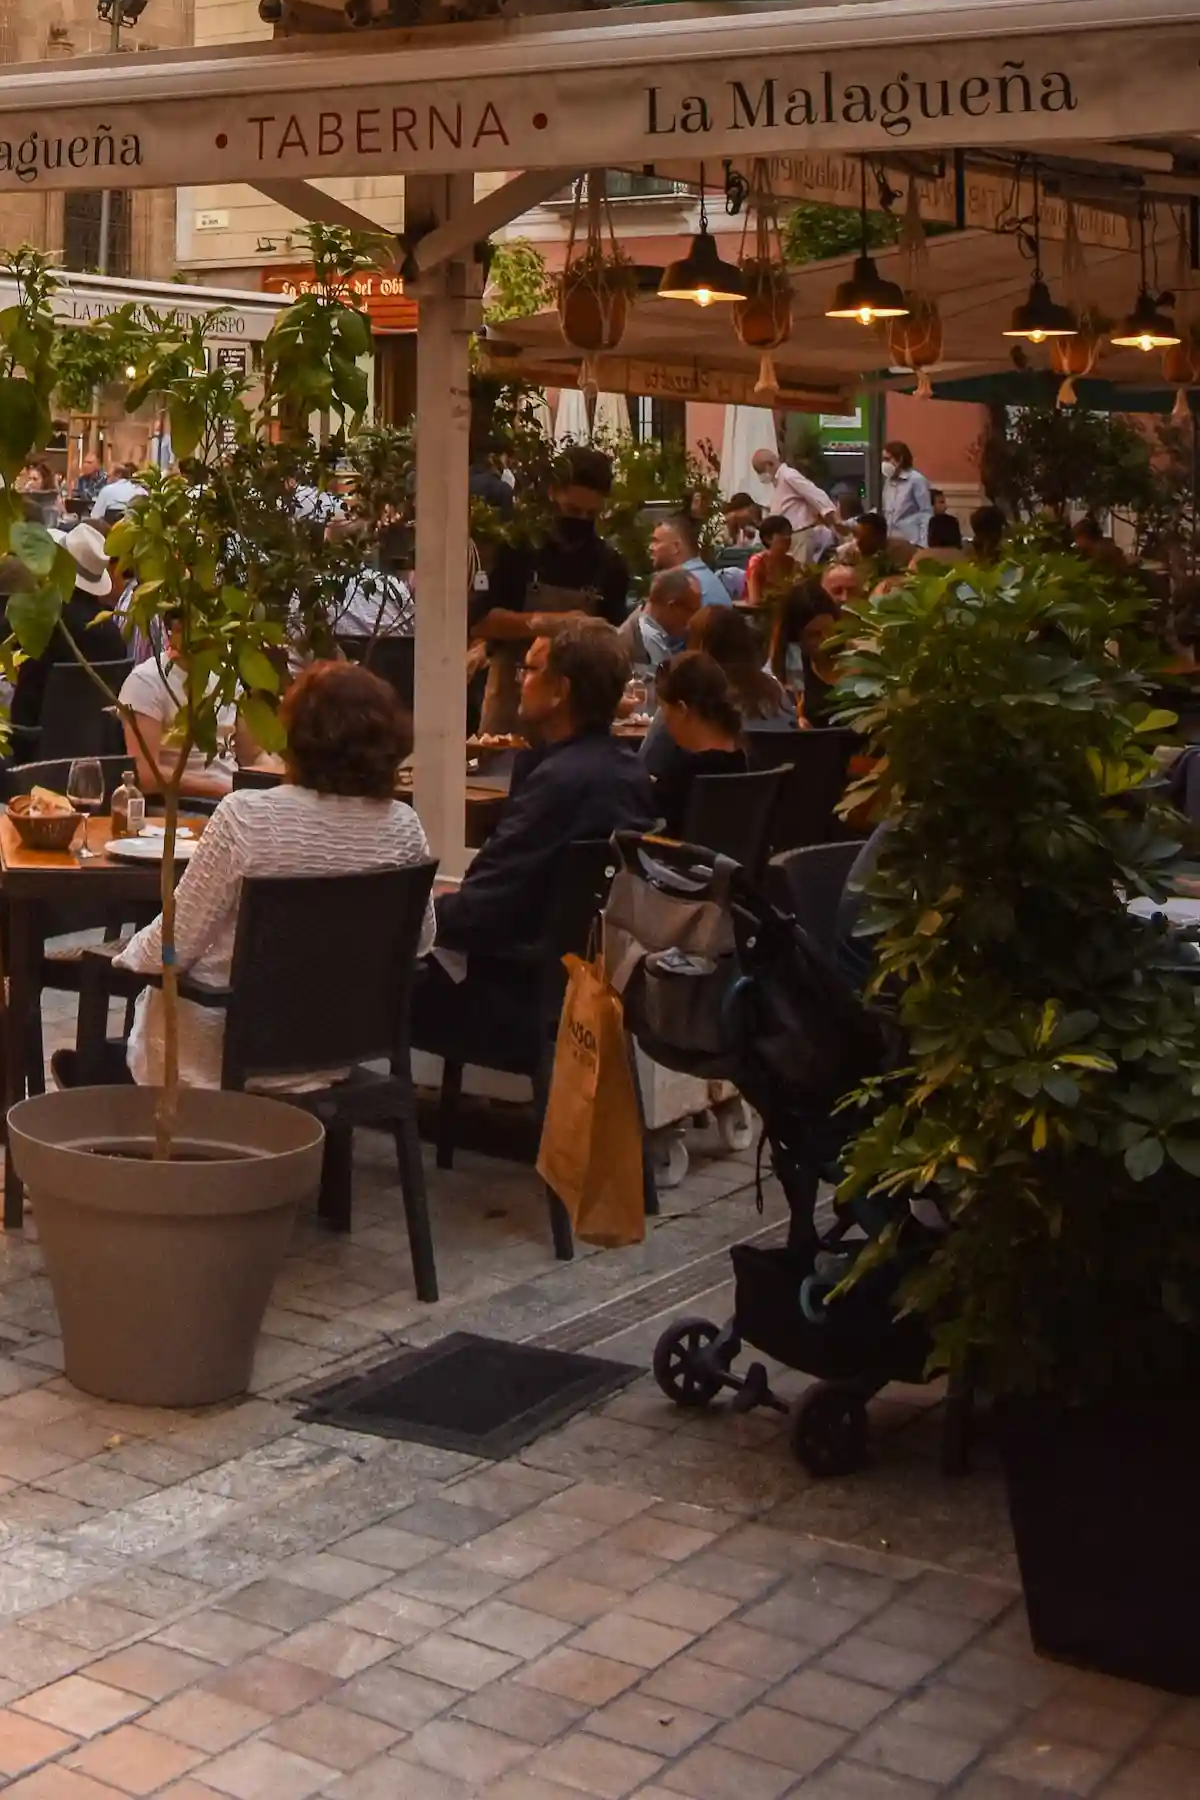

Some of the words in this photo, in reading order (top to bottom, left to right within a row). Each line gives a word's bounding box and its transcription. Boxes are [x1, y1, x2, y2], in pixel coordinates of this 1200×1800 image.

[643, 86, 714, 135] La
[726, 60, 1079, 137] Malagueña
[247, 101, 510, 160] TABERNA
[355, 278, 373, 296] del
[380, 277, 404, 296] Obi
[72, 301, 91, 321] LA
